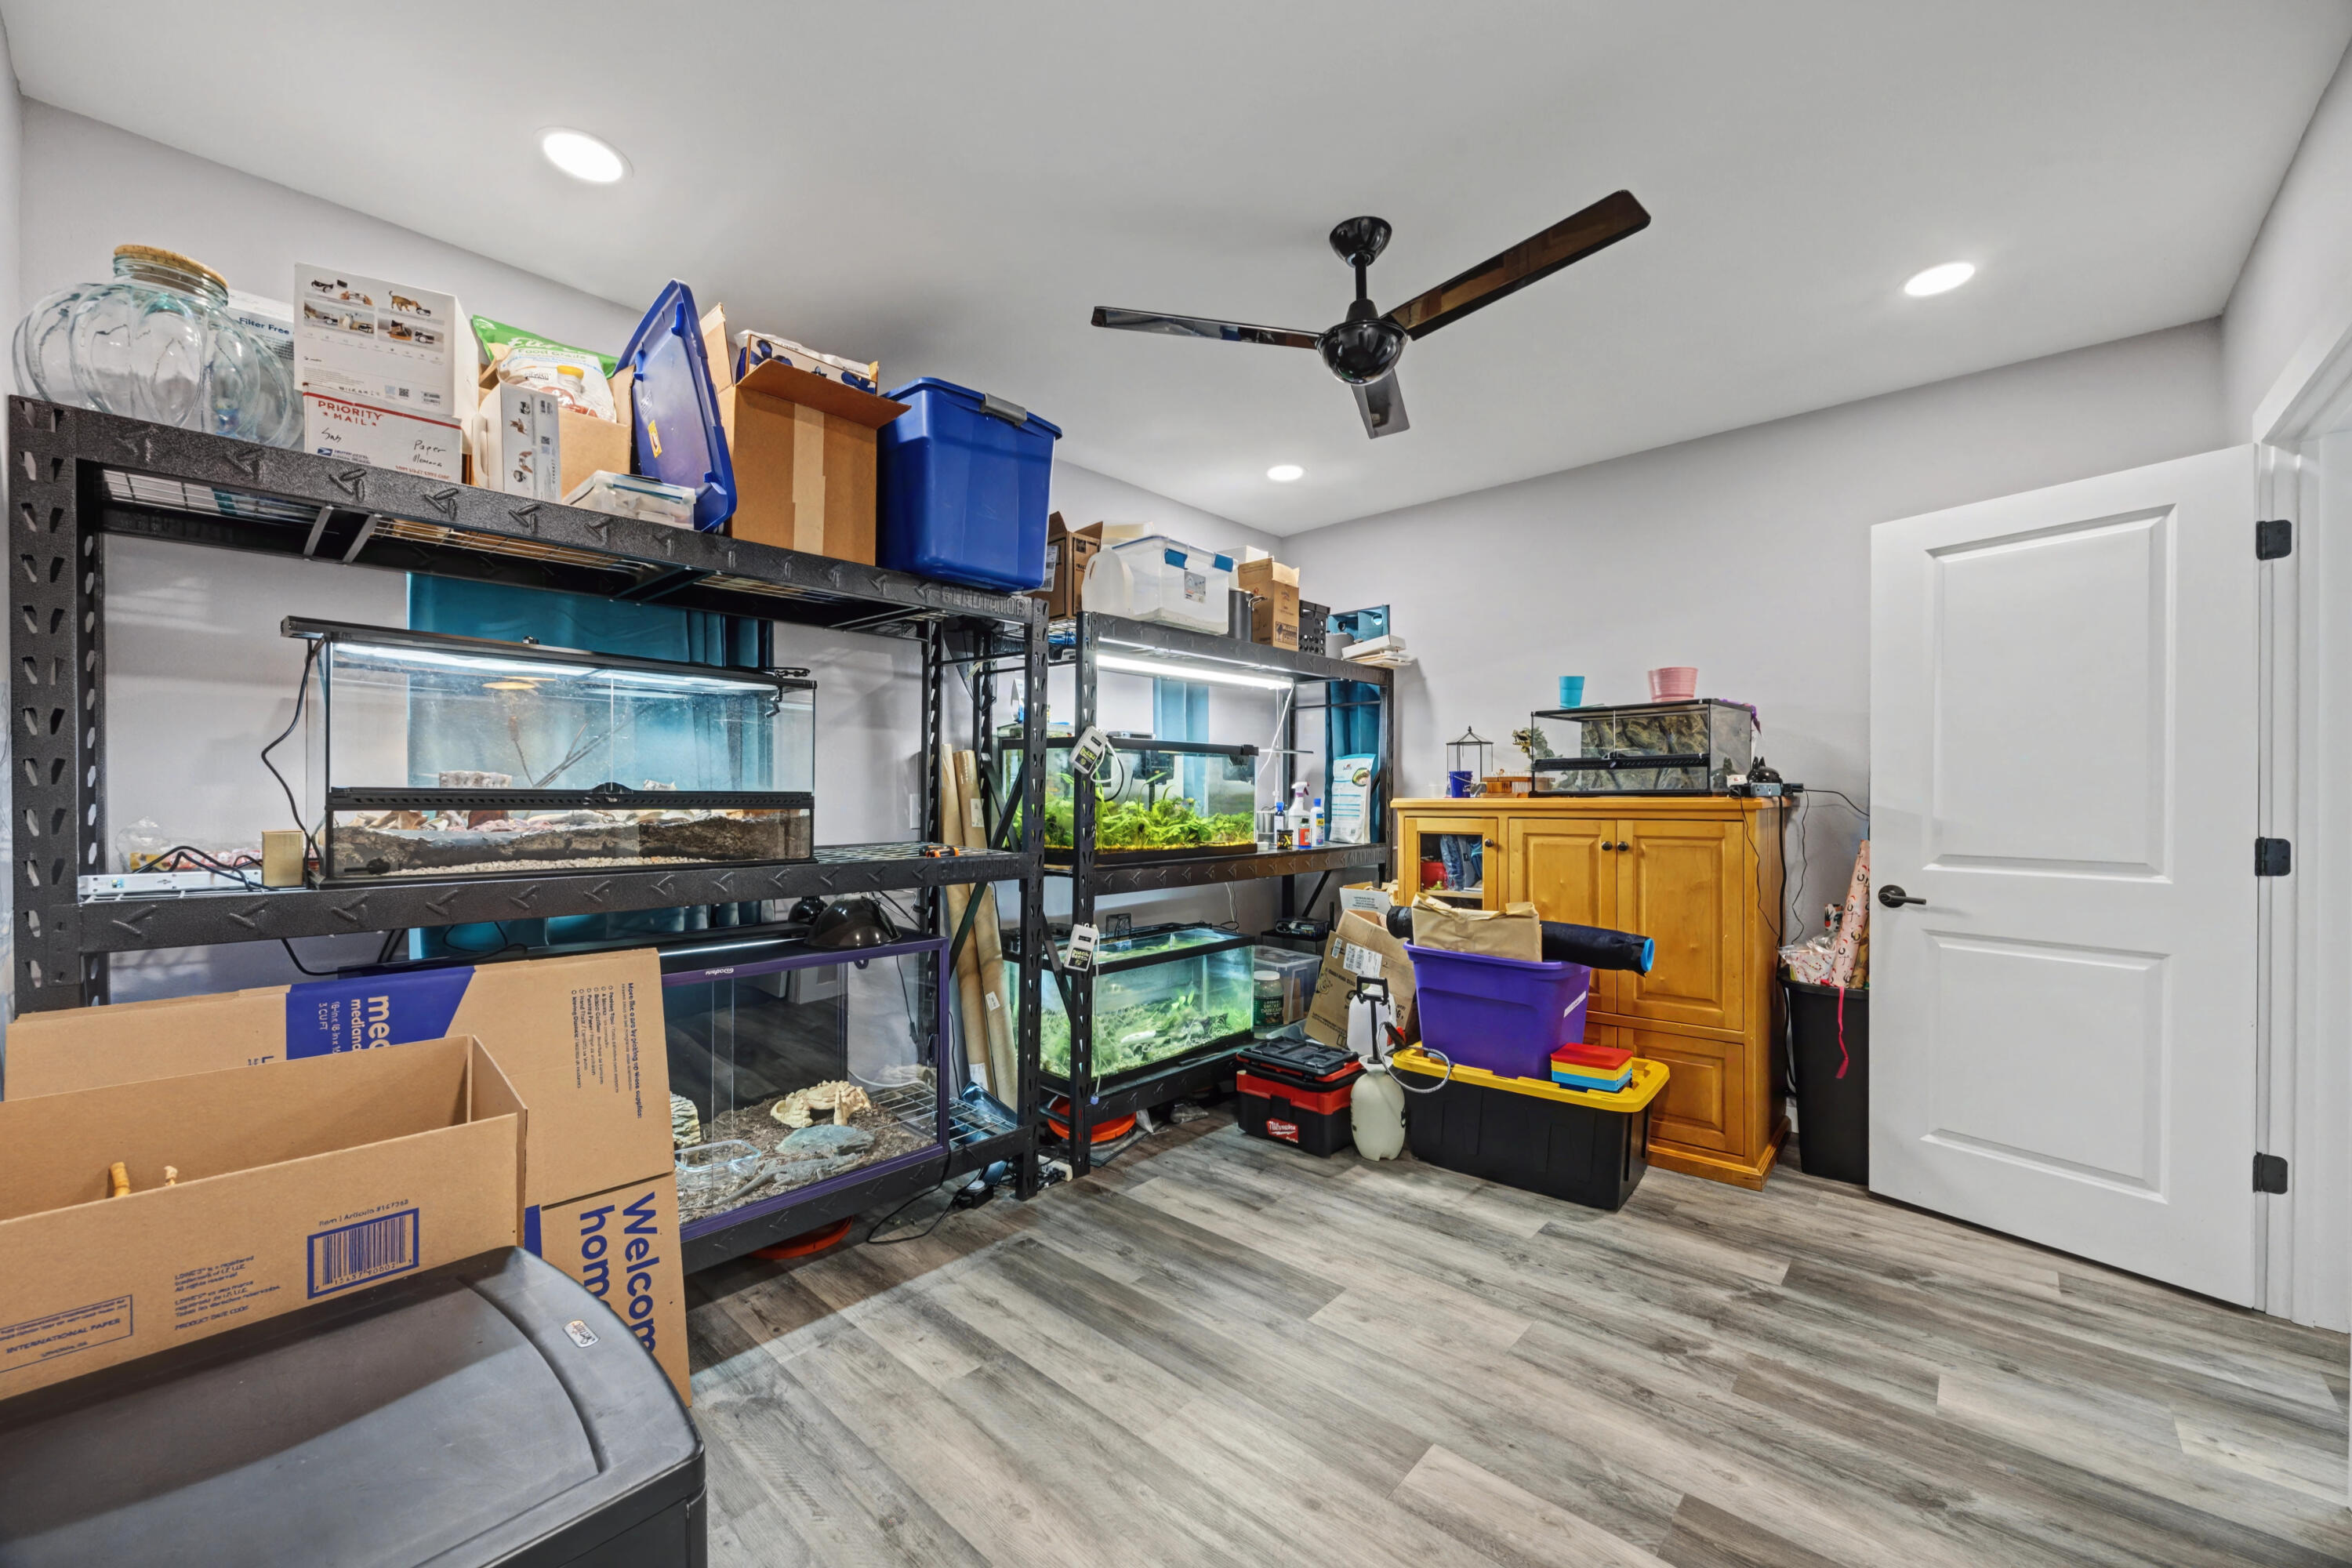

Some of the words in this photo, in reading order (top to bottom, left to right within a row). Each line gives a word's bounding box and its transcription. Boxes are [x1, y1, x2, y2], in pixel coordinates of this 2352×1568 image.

[238, 317, 265, 329] Filter
[268, 322, 290, 336] Free
[318, 400, 383, 421] PRIORITY
[333, 413, 367, 426] MAIL
[414, 440, 446, 456] Paper
[580, 1204, 615, 1308] hom
[6, 1327, 88, 1354] INTERNATIONAL
[90, 1318, 121, 1330] PAPER
